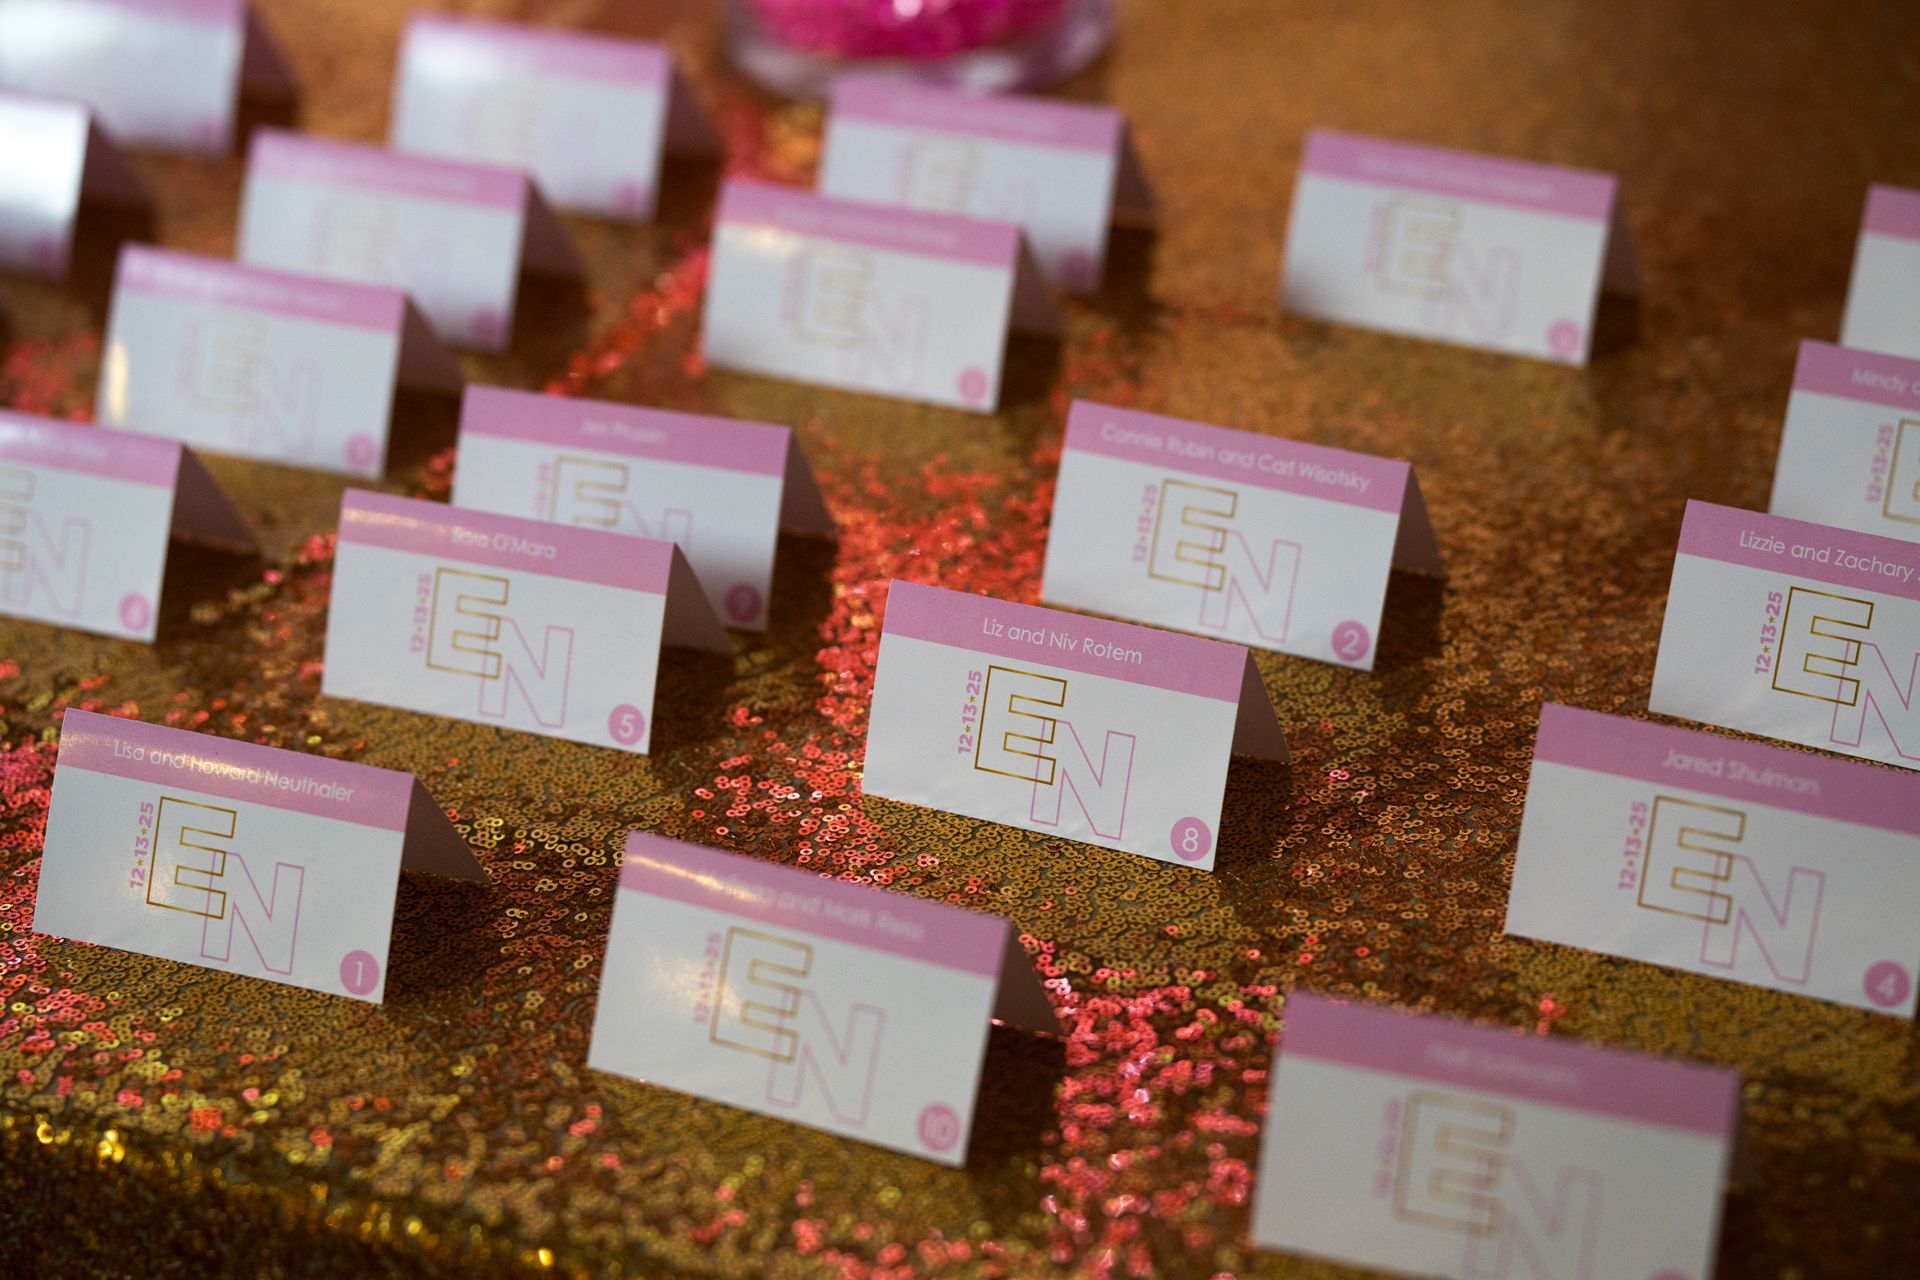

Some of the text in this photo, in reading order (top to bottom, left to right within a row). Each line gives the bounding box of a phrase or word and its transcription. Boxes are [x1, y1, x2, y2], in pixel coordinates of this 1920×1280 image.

[1101, 423, 1162, 449] Connie
[1165, 434, 1215, 461] Rubin
[1219, 445, 1254, 468] and
[1257, 453, 1295, 475] Carl
[1148, 477, 1302, 645] EN
[1739, 529, 1915, 584] Lizzie and Zachary
[425, 566, 575, 730] EN
[983, 616, 1143, 665] Liz and Niv Rotem
[114, 740, 354, 802] Lisa and Howard Neuthaler
[973, 664, 1137, 842] EN
[1661, 748, 1820, 795] Jared Shulman
[146, 796, 305, 976] EN
[1182, 827, 1199, 852] 8
[1637, 795, 1826, 985] EN
[708, 925, 887, 1128] EN
